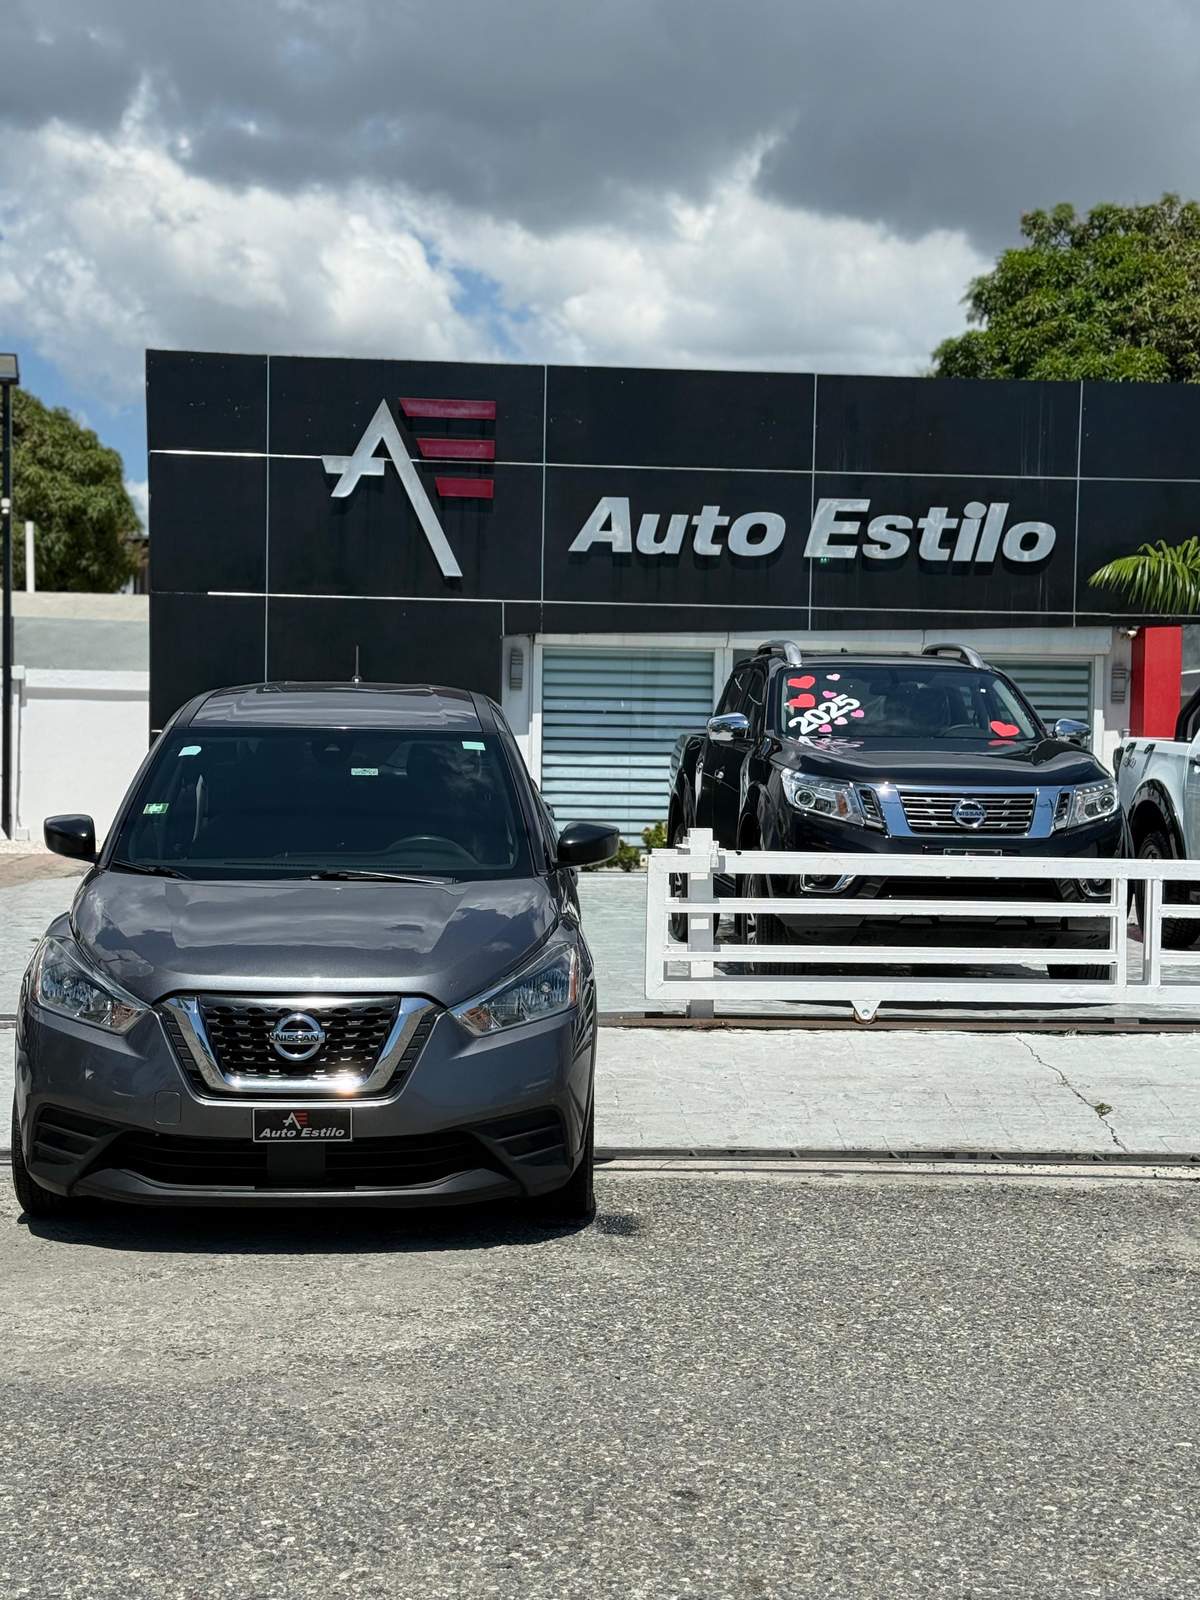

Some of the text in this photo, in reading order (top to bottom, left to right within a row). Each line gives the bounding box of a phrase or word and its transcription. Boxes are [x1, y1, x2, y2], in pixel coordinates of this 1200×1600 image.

[568, 496, 1057, 563] Auto Estilo
[788, 693, 861, 735] 2025
[275, 1033, 319, 1042] NISSAN
[259, 1127, 345, 1138] Auto Estilo
